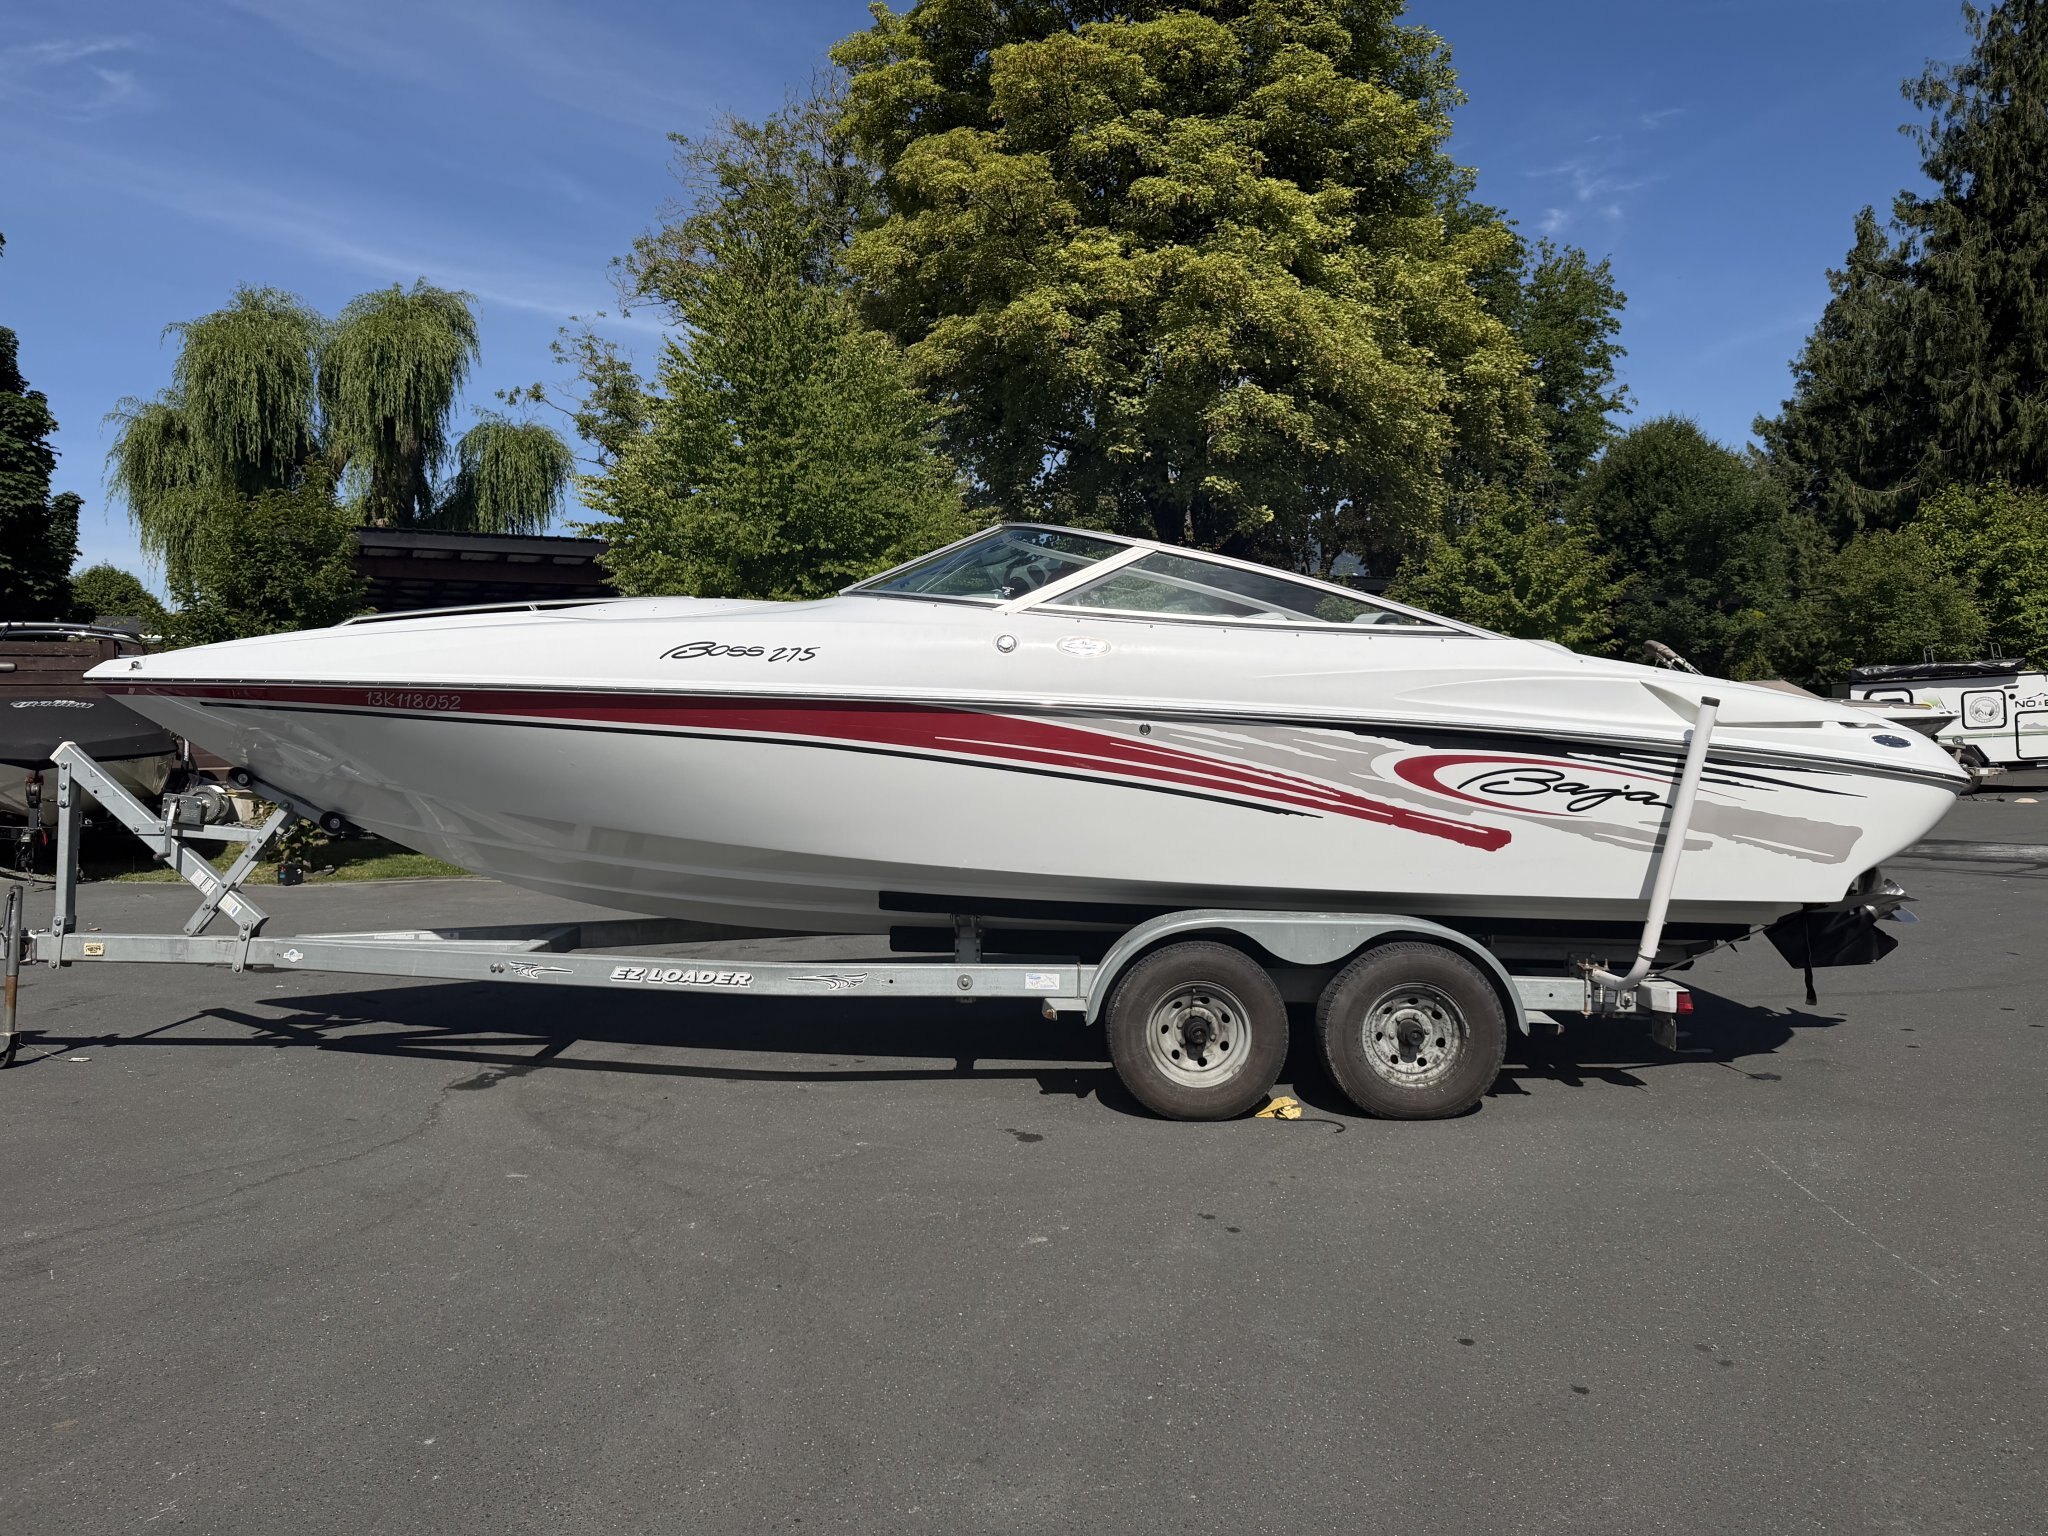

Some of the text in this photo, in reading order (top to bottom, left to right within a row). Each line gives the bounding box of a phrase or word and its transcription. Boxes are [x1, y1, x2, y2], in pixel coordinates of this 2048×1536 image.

[768, 647, 821, 662] 275
[1457, 768, 1673, 812] Baja
[611, 966, 754, 988] EZ LOADER
